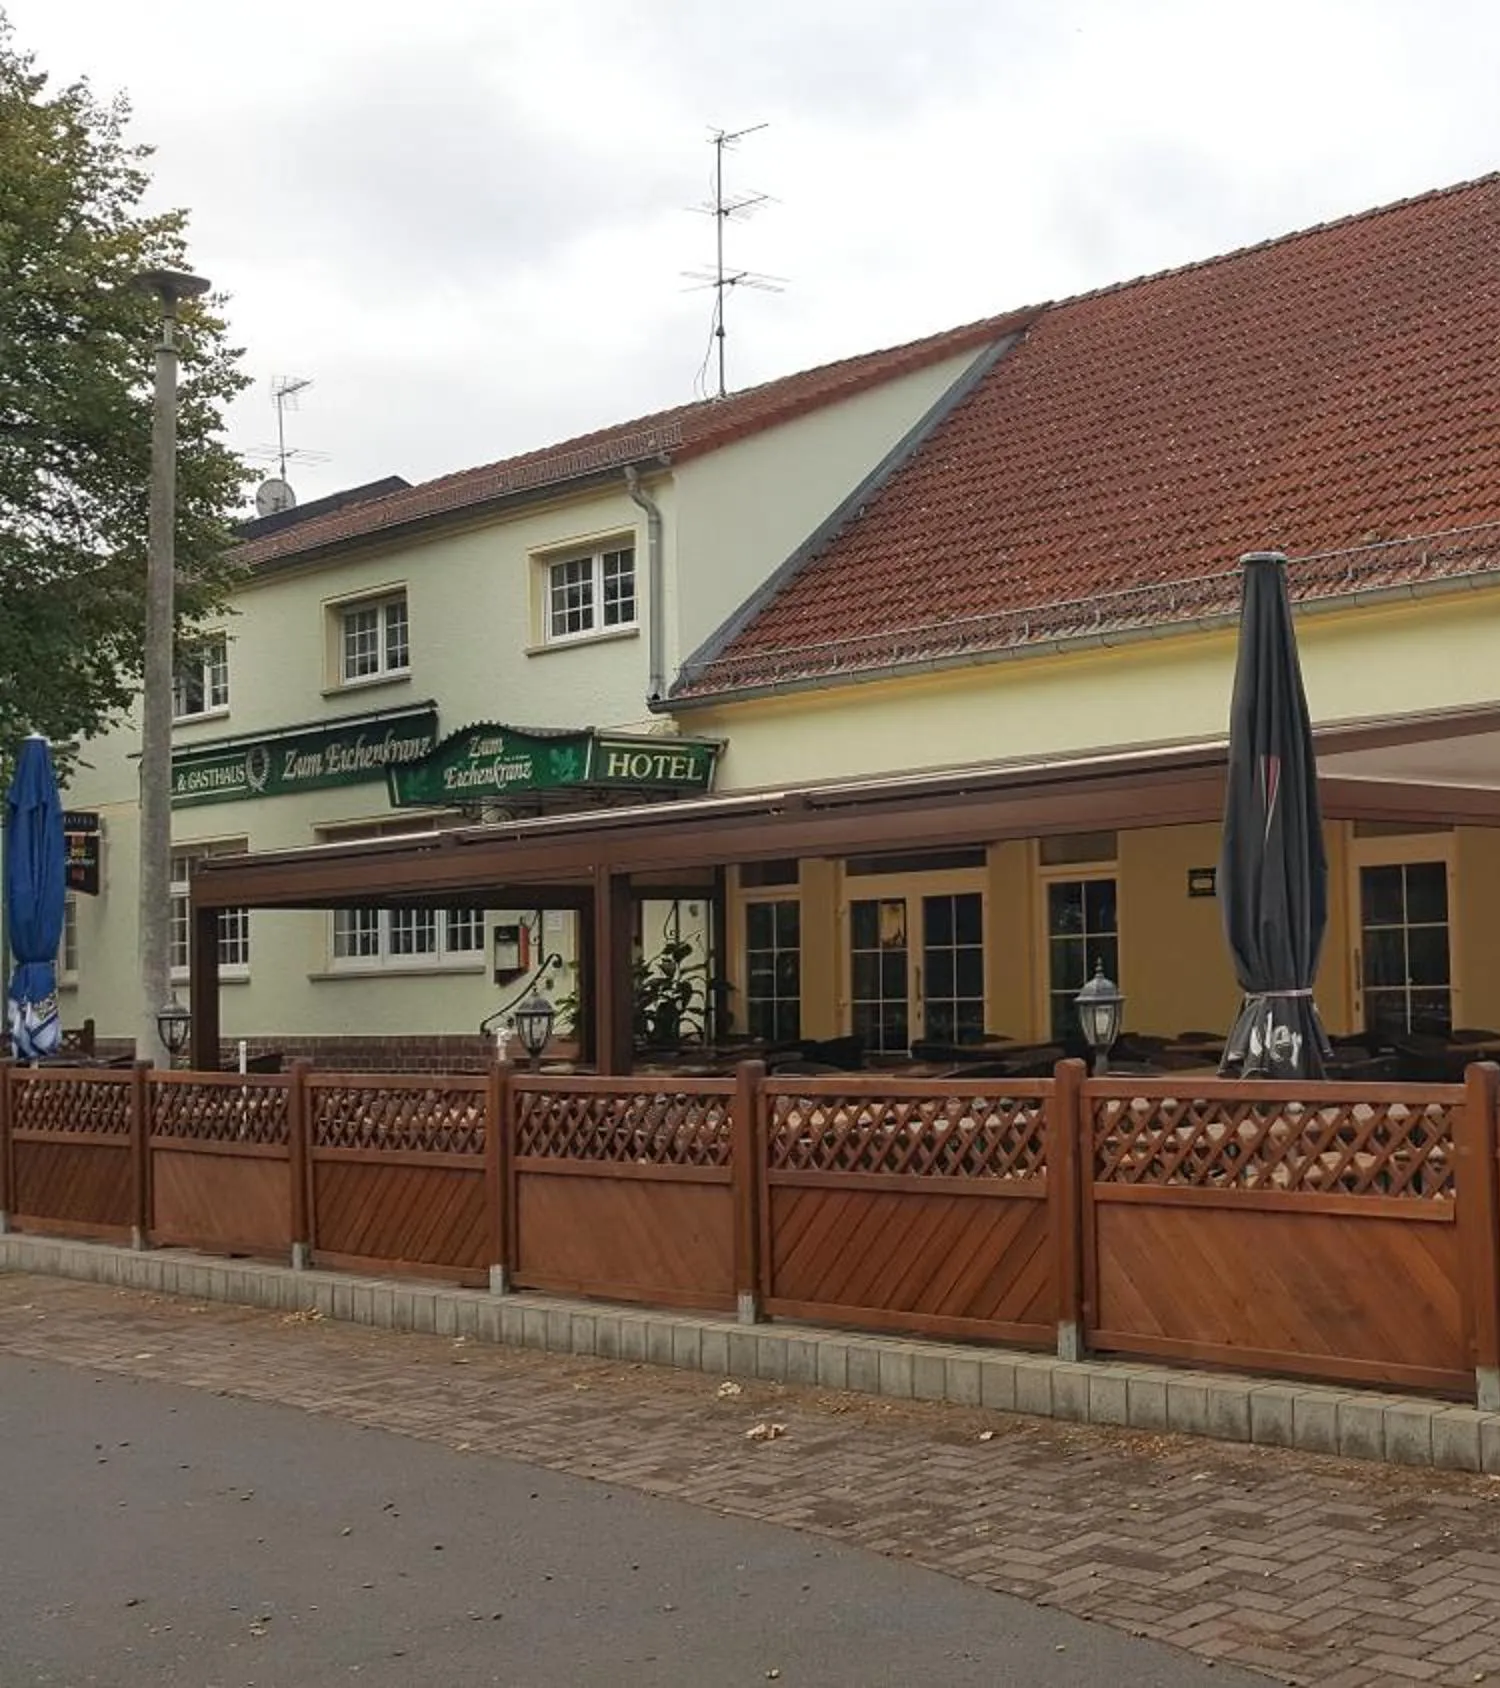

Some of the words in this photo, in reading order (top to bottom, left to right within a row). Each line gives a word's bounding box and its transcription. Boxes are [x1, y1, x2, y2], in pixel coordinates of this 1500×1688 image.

[281, 750, 323, 781] Zum
[324, 728, 433, 776] Eichenkranz
[468, 736, 504, 758] Zum
[177, 772, 186, 791] &
[187, 764, 246, 789] GASTHAUS
[443, 756, 533, 790] Eichenkranz
[607, 753, 703, 781] HOTEL
